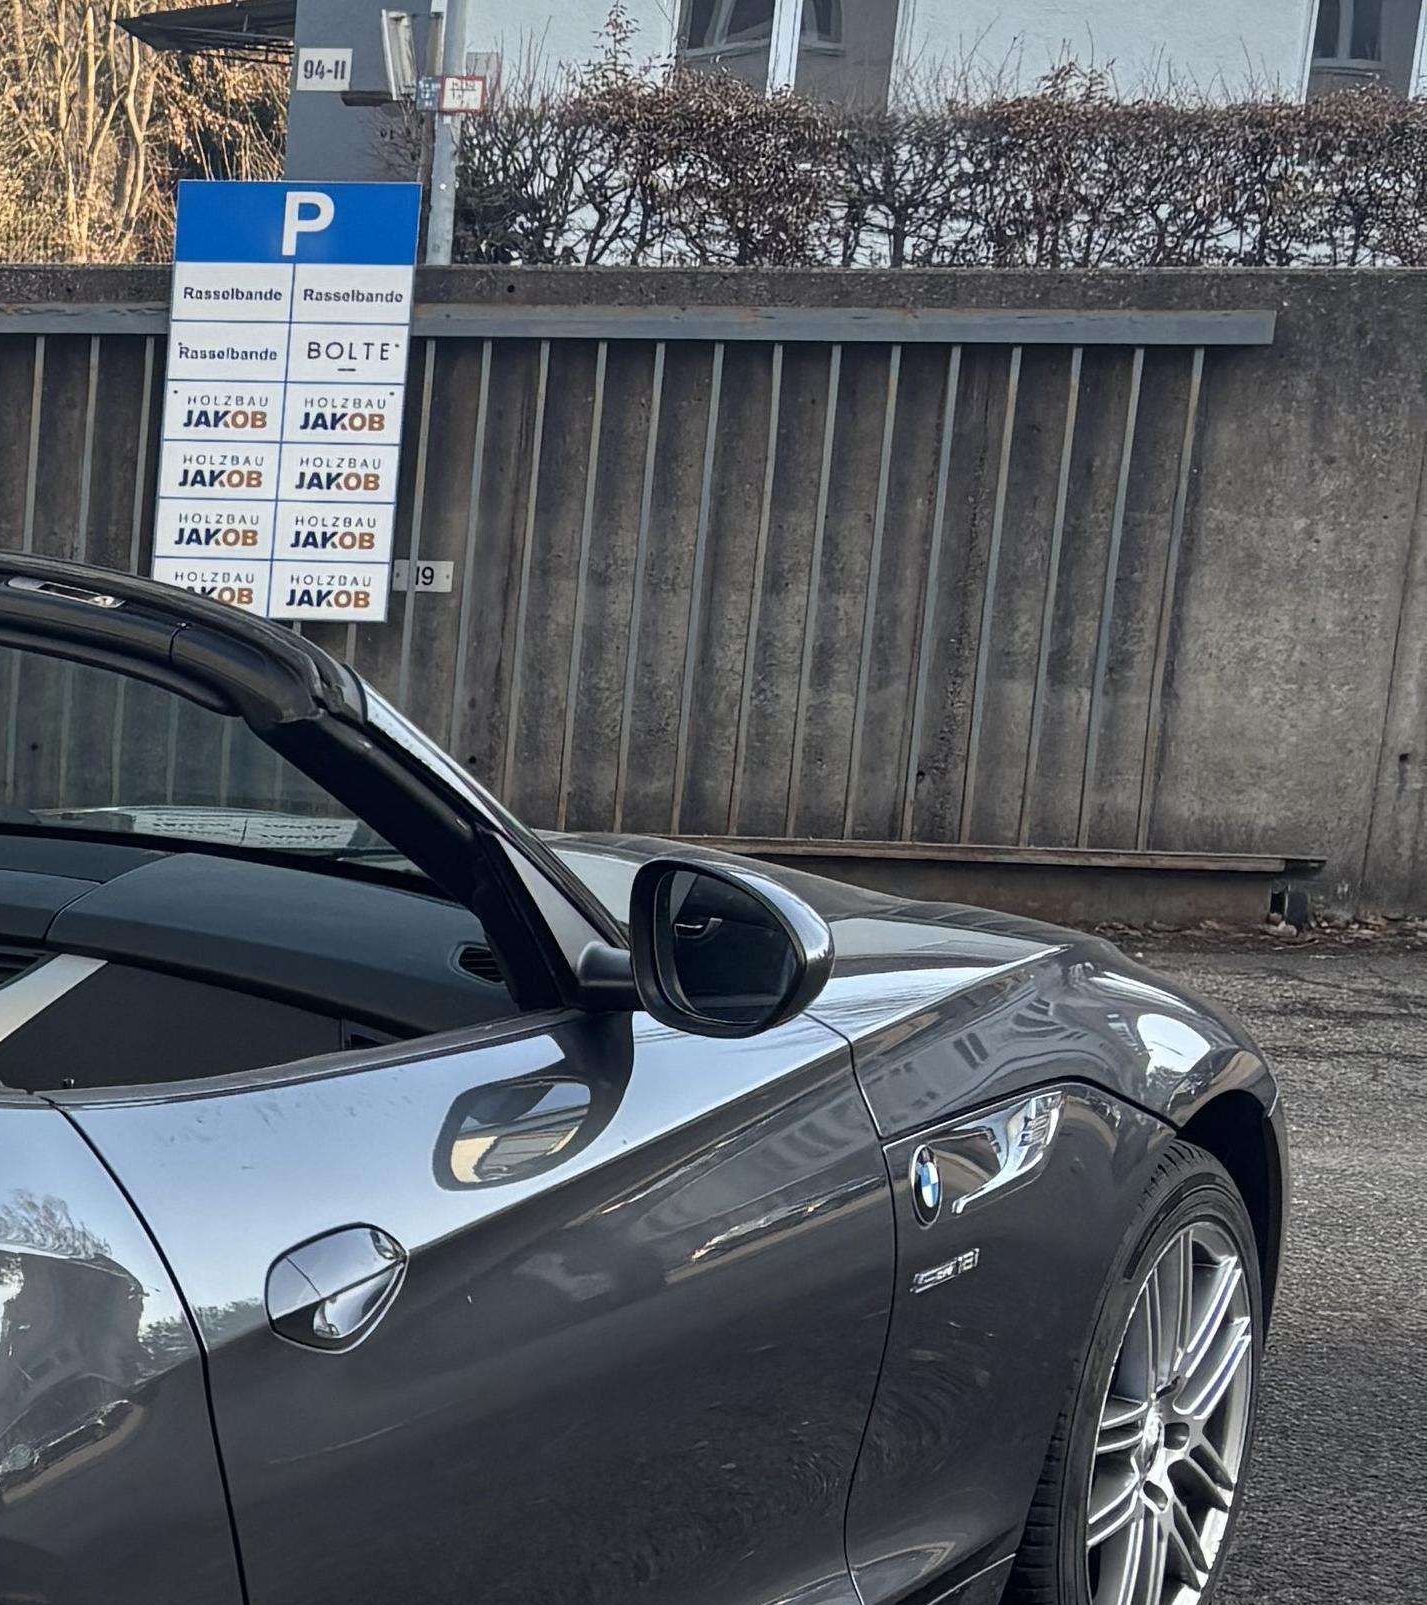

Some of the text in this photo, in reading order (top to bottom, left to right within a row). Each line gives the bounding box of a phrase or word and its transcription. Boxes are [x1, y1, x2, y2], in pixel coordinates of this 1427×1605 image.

[281, 191, 335, 256] P
[183, 287, 283, 302] Rasselbande
[303, 288, 403, 303] Rasselbande
[178, 345, 278, 361] Rasselbande
[307, 341, 390, 361] BOLTE
[187, 394, 268, 407] HOLZBAU
[304, 397, 386, 409] HOLZBAU
[183, 410, 267, 429] JAKOB
[299, 412, 385, 431] JAKOB
[183, 454, 264, 467] HOLZBAU
[299, 457, 381, 470] HOLZBAU
[178, 469, 263, 488] JAKOB
[295, 472, 380, 491] JAKOB
[179, 513, 259, 525] HOLZBAU
[295, 516, 376, 528] HOLZBAU
[174, 528, 258, 547] JAKOB
[290, 531, 375, 550] JAKOB
[174, 571, 255, 583] HOLZBAU
[291, 574, 372, 587] HOLZBAU
[415, 566, 435, 586] 19
[186, 586, 254, 605] KOB
[286, 589, 370, 609] JAKOB
